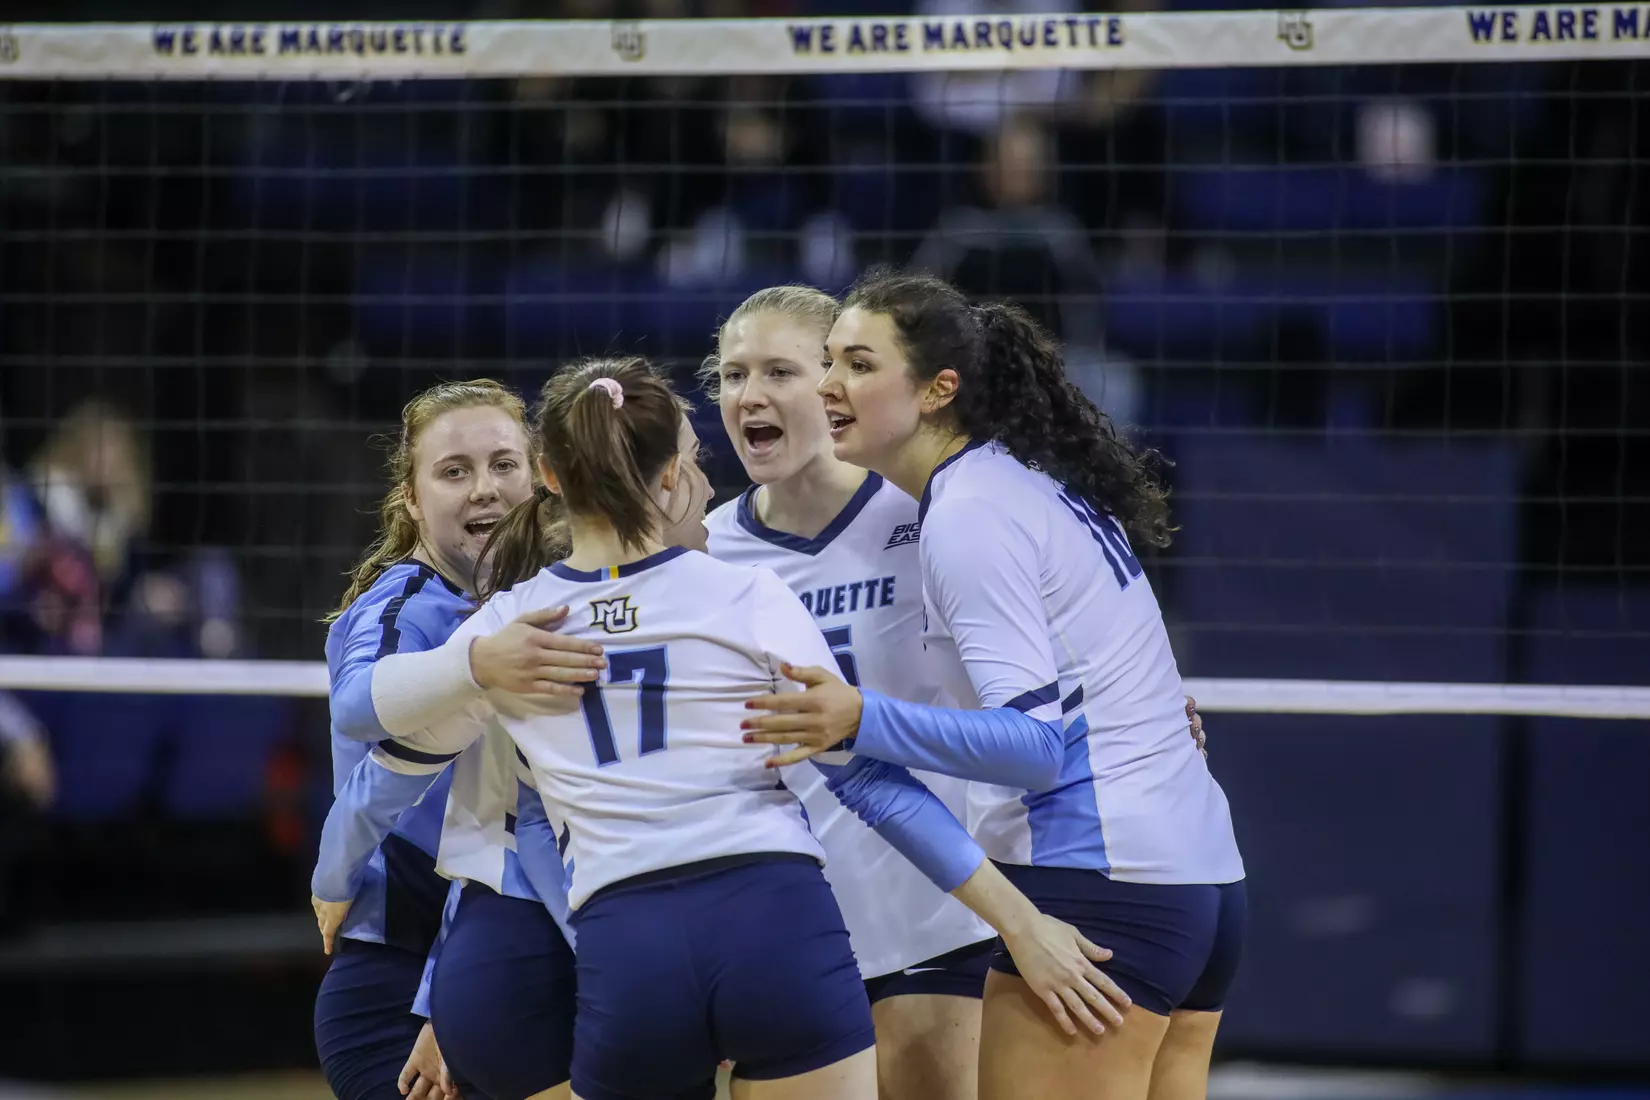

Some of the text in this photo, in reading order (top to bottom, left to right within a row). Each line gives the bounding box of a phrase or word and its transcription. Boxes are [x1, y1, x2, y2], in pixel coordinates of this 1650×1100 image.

[153, 24, 467, 56] WE ARE MARQUETTE
[790, 18, 1125, 53] WE ARE MARQUETTE
[1467, 10, 1518, 43] WE
[1531, 9, 1599, 42] ARE
[589, 596, 639, 634] MU
[576, 644, 671, 768] 17
